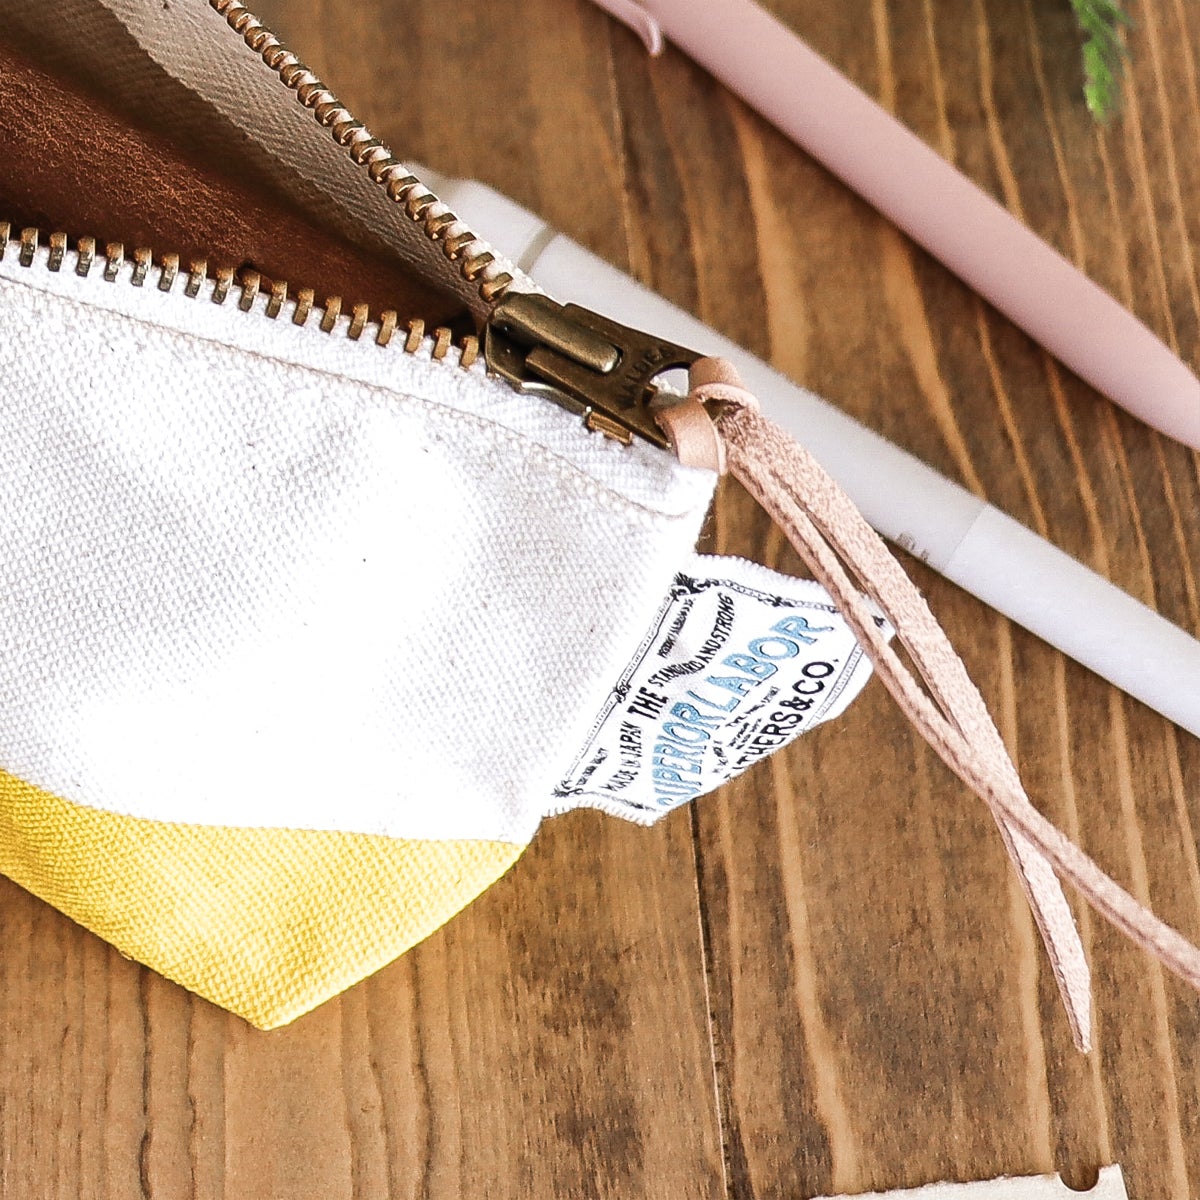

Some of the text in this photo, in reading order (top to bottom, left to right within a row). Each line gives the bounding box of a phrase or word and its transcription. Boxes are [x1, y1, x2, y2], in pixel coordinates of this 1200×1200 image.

[710, 592, 735, 643] STRONG
[647, 660, 706, 688] STANDARD
[686, 614, 835, 714] LABOR
[626, 686, 669, 720] THE
[599, 768, 639, 792] MADE
[619, 719, 643, 758] JAPAN
